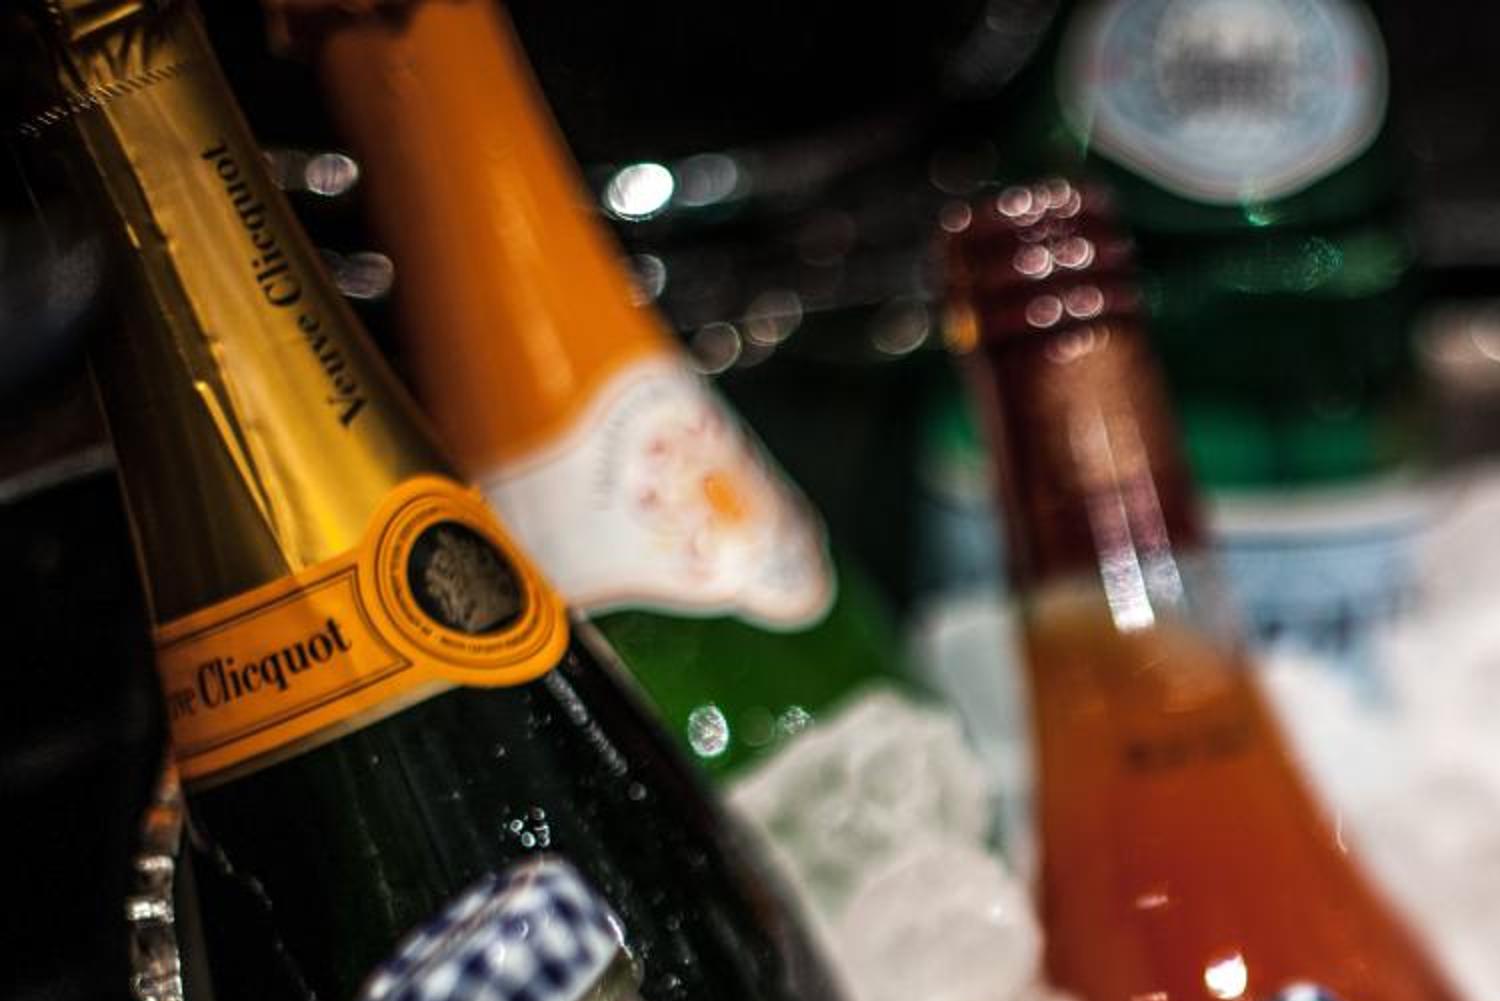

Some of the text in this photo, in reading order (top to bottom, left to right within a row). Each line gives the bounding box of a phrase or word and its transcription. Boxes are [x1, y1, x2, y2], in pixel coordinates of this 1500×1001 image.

[201, 143, 367, 428] Veuve Clicquot
[197, 614, 353, 709] Clicquot
